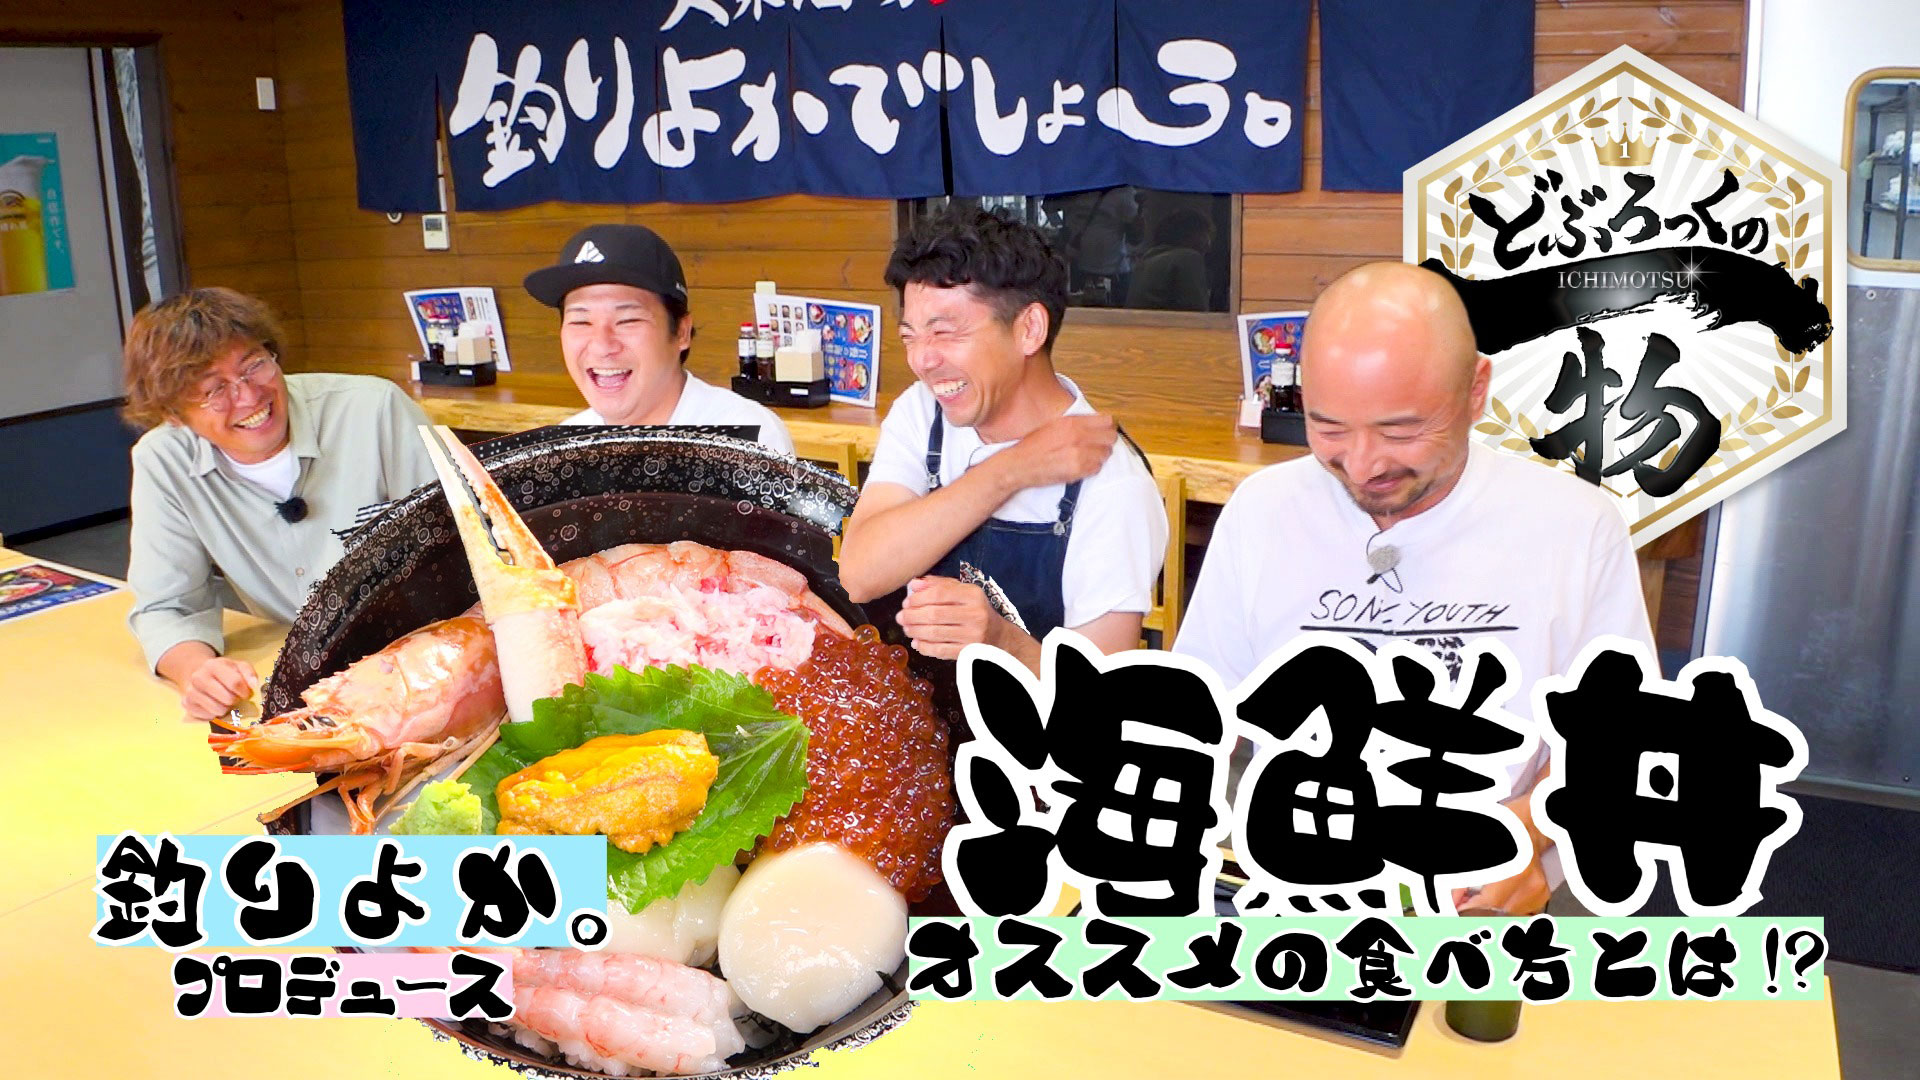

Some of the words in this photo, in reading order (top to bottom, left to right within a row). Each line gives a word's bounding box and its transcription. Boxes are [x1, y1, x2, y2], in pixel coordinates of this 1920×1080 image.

[450, 33, 1291, 188] 釣りよかでしょう。
[1403, 601, 1511, 626] YOUTH
